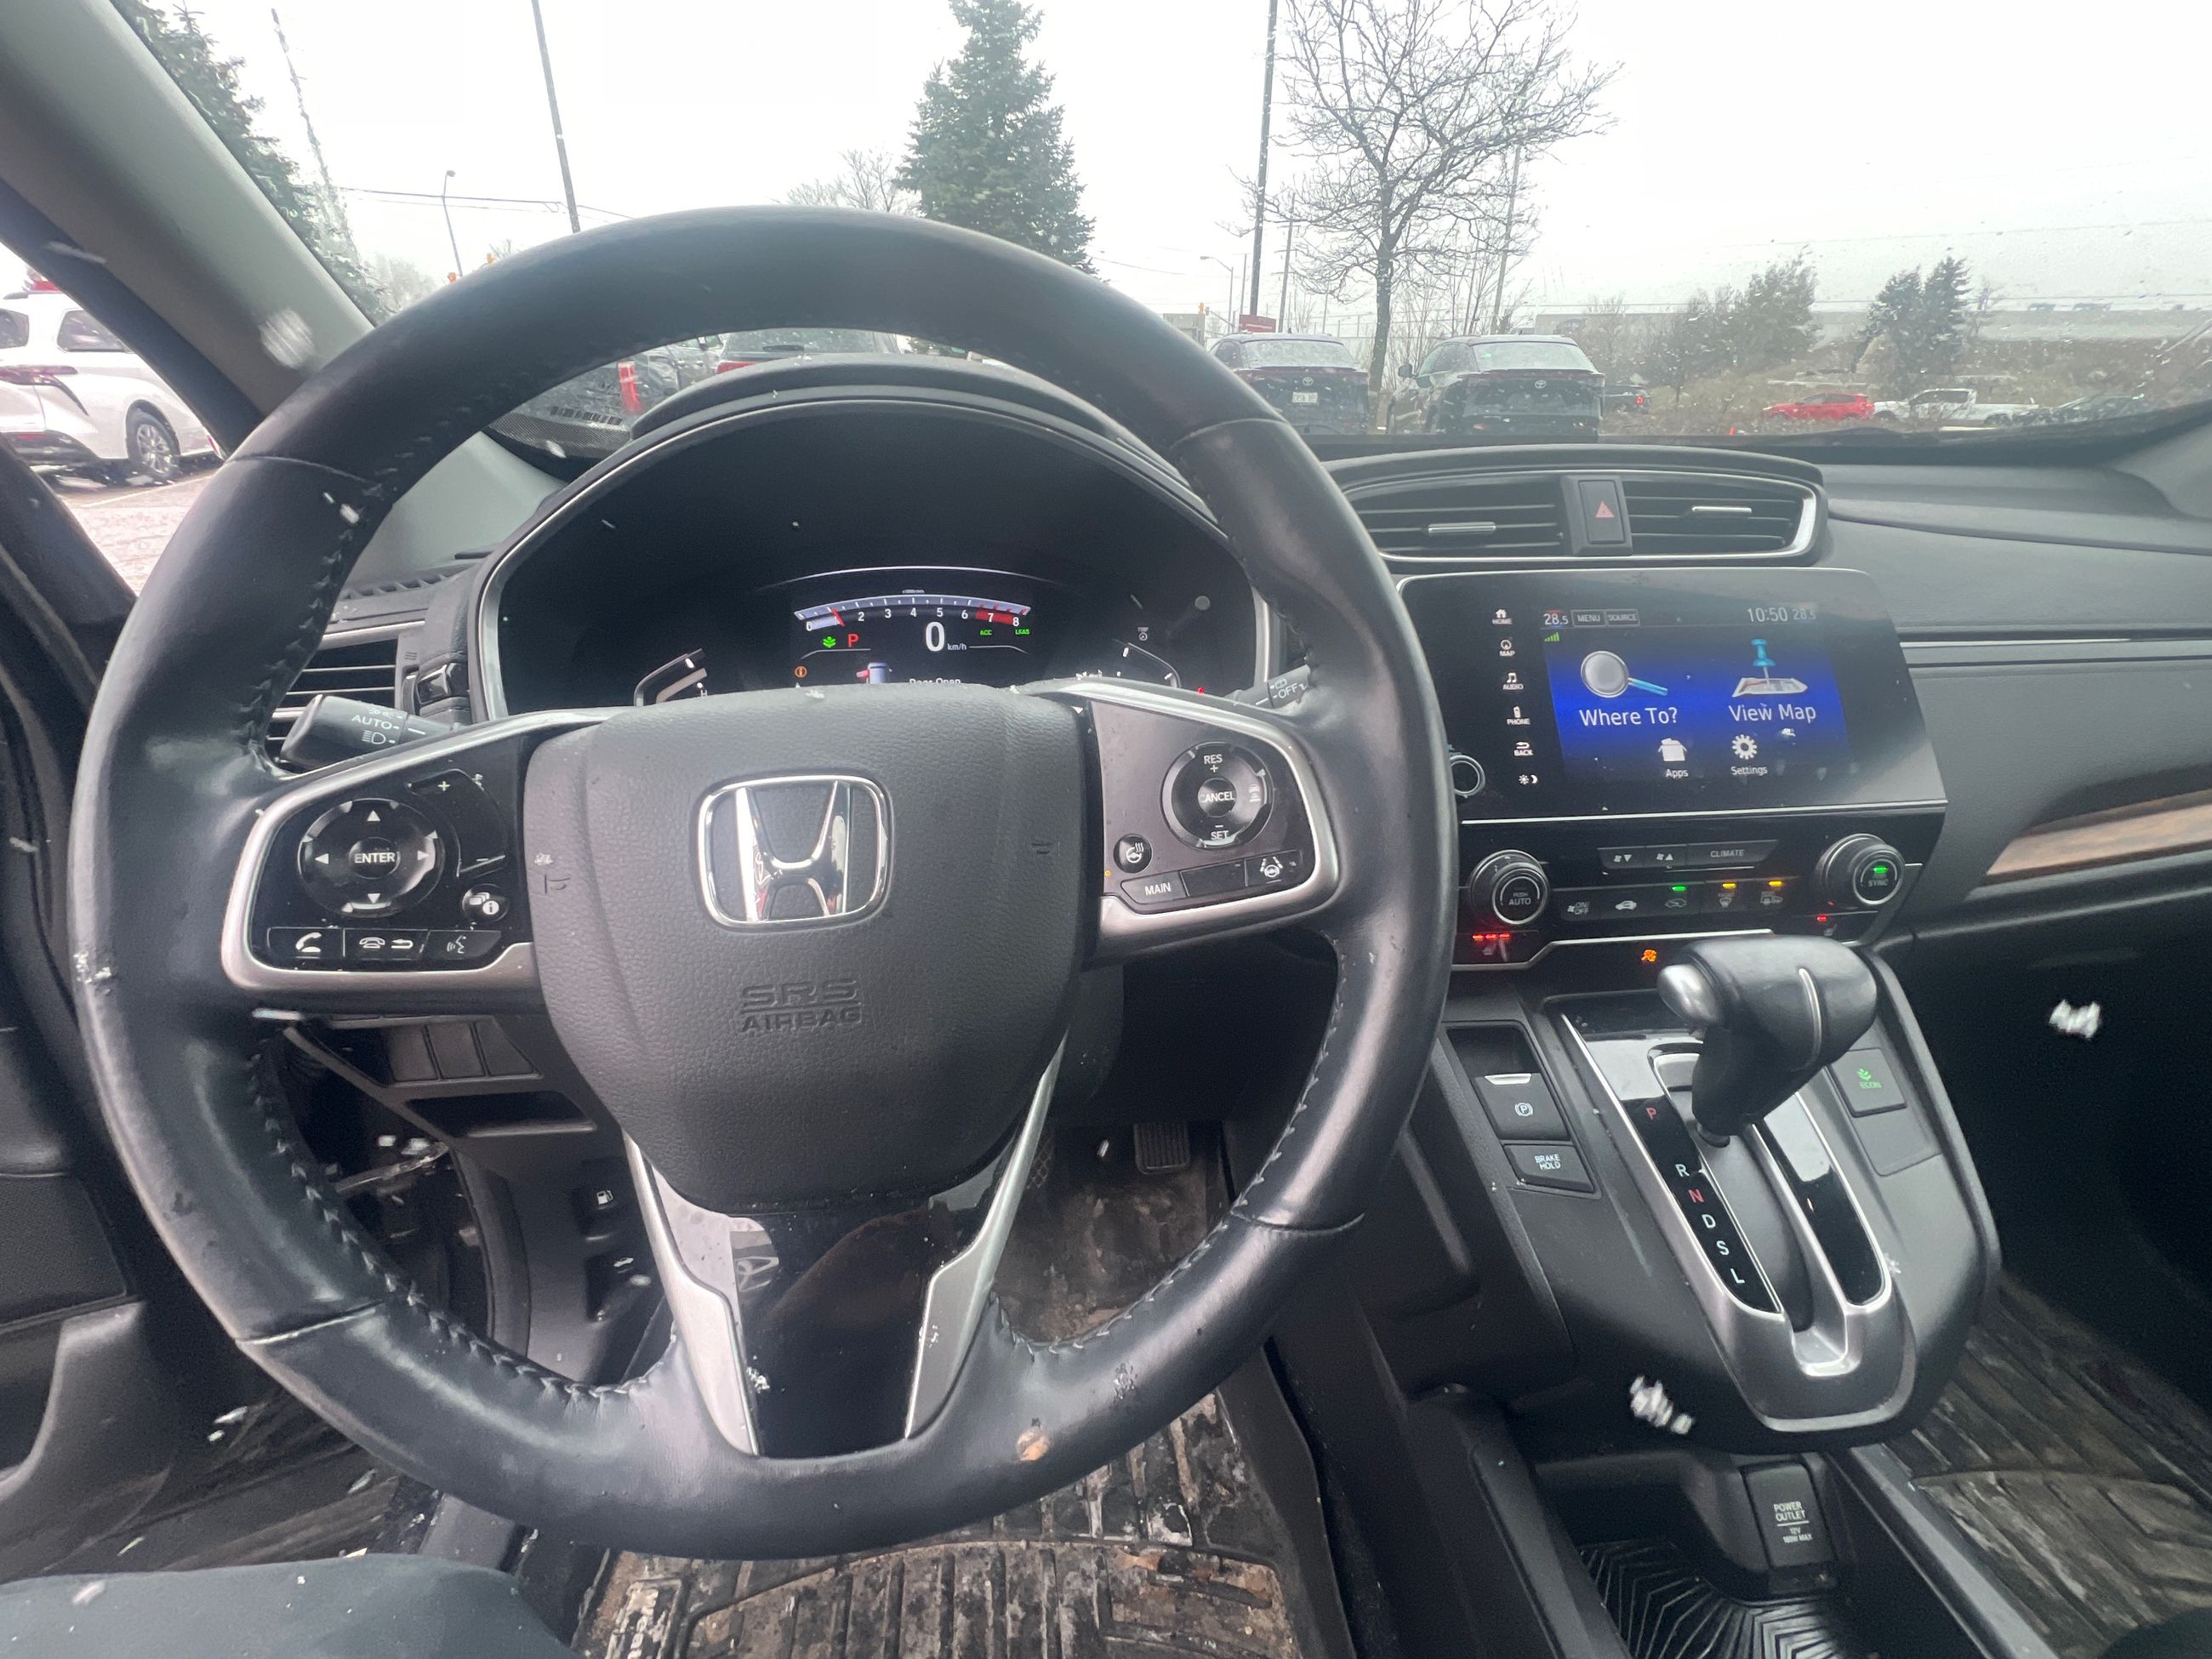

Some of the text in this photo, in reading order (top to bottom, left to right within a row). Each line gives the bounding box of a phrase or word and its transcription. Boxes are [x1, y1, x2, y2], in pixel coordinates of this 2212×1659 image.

[858, 611, 865, 622] 2
[885, 608, 892, 619] 3
[910, 607, 917, 618] 4
[937, 607, 944, 618] 5
[961, 609, 968, 619] 6
[988, 613, 995, 622] 7
[1012, 616, 1019, 627] 8
[1543, 613, 1569, 625] 28.5
[1747, 607, 1788, 622] 10:50
[1792, 607, 1816, 620] 28.5
[848, 633, 858, 647] P
[926, 621, 945, 652] 0
[1278, 682, 1298, 698] OFF
[1579, 707, 1678, 727] Where To?
[1729, 704, 1816, 724] View Map
[351, 715, 393, 730] AUTO
[1203, 754, 1223, 765] RES
[1666, 768, 1689, 778] Apps
[1730, 766, 1769, 776] Settings
[1200, 791, 1235, 802] CANCEL
[1211, 830, 1229, 841] SET
[354, 852, 396, 864] ENTER
[1710, 849, 1746, 858] CLIMATE
[1144, 882, 1172, 896] MAIN
[1508, 898, 1531, 906] AUTO
[743, 980, 859, 1007] SRS
[743, 1006, 863, 1032] AIRBAG
[1645, 1107, 1657, 1120] P
[1535, 1154, 1560, 1164] BRAKE
[1539, 1161, 1561, 1171] HOLD
[1675, 1164, 1690, 1177] R
[1688, 1189, 1705, 1203] N
[1702, 1214, 1717, 1229] D
[1716, 1240, 1730, 1256] S
[1730, 1268, 1745, 1284] L
[1774, 1501, 1803, 1513] POWER
[1776, 1510, 1806, 1521] OUTLET
